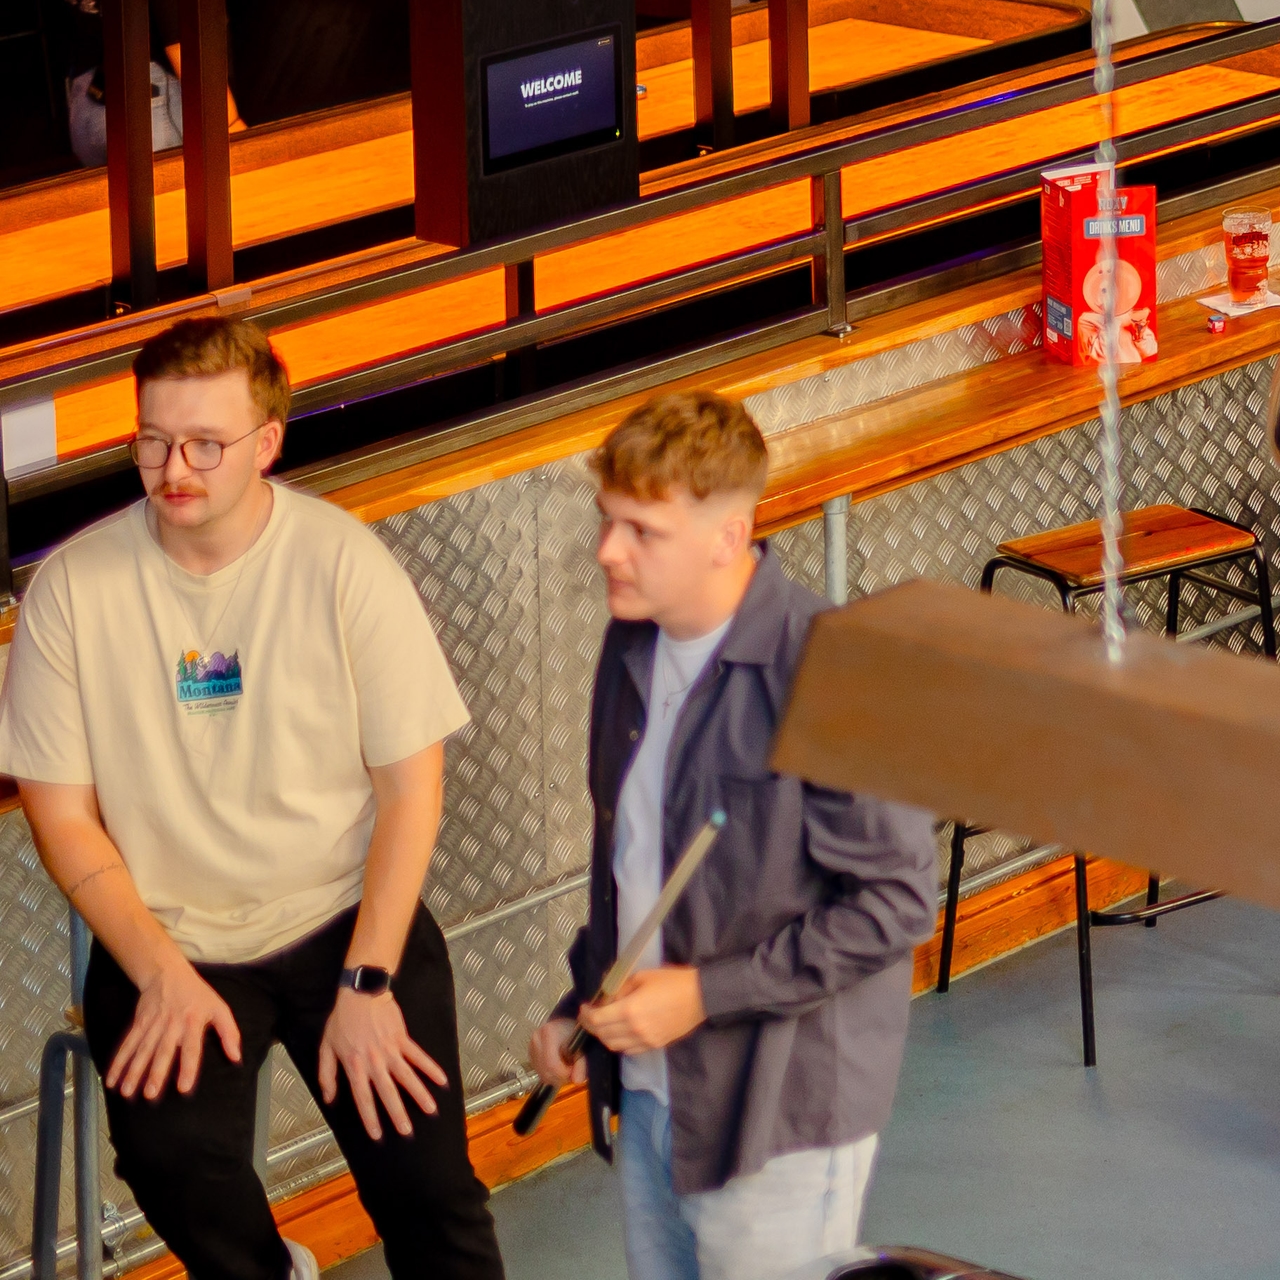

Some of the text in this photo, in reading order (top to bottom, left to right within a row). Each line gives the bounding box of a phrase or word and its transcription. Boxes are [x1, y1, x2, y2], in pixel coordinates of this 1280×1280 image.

[520, 70, 582, 98] WELCOME
[1118, 219, 1141, 233] MENU
[180, 682, 240, 699] Montana
